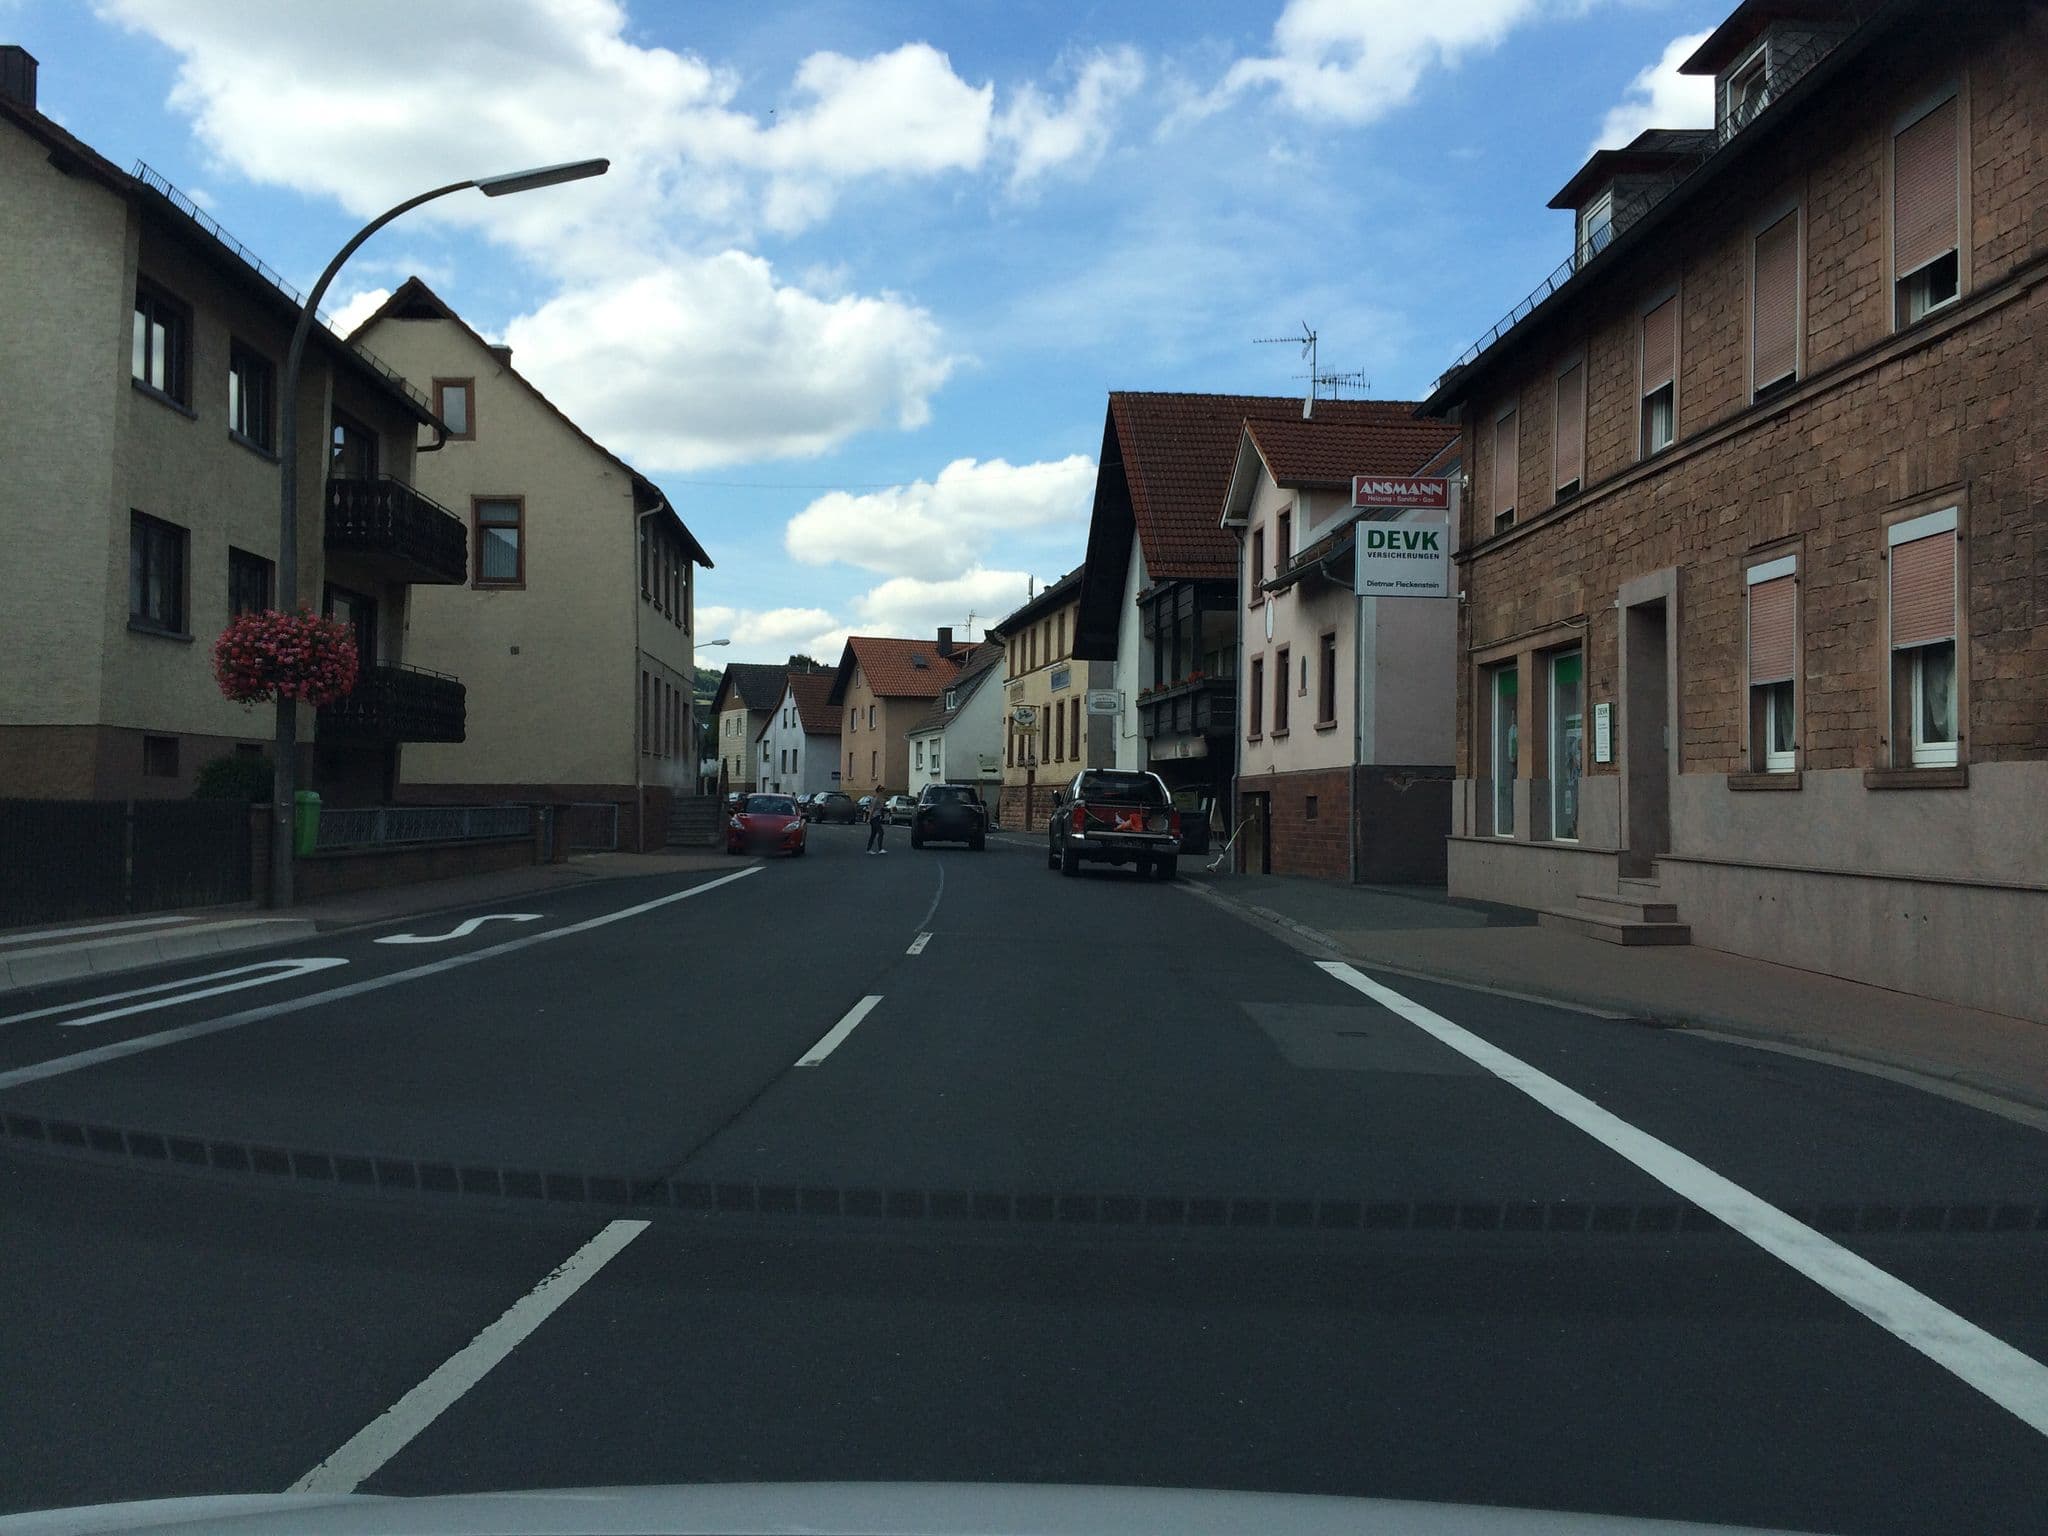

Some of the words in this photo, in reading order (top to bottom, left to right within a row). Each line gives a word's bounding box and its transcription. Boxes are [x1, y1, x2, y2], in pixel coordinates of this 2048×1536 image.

[1360, 481, 1443, 497] ANSMANN
[1367, 529, 1440, 551] DEVK
[1367, 552, 1440, 560] VERSICHERUNGEN
[1367, 580, 1394, 588] Dietmar
[1395, 581, 1440, 589] Fleckenstein
